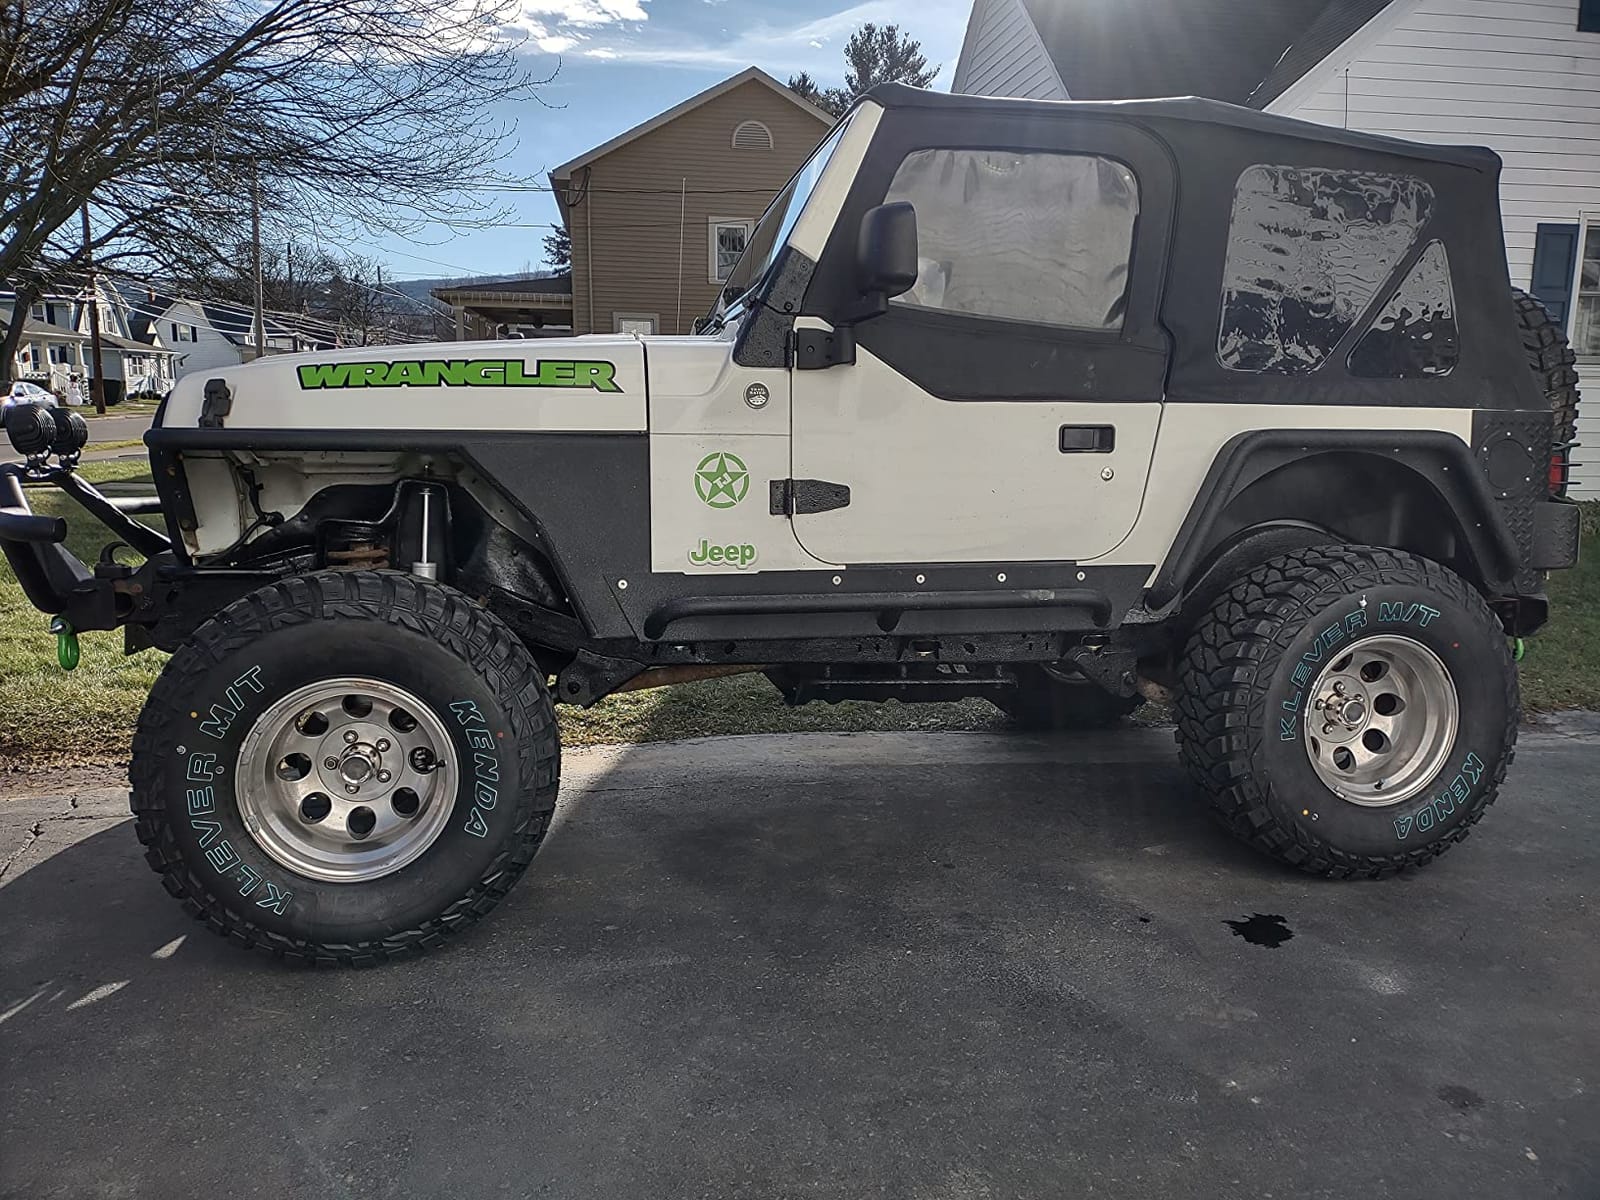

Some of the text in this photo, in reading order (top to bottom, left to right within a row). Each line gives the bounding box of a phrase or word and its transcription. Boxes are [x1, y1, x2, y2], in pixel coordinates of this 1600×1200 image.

[297, 359, 624, 393] WRANGLER
[713, 472, 732, 489] TJ
[691, 540, 755, 565] Jeep
[1281, 602, 1440, 741] KLEVER M/T
[187, 666, 293, 915] KLEVER M/T
[449, 700, 500, 838] KENDA
[1394, 753, 1485, 839] KENDA
